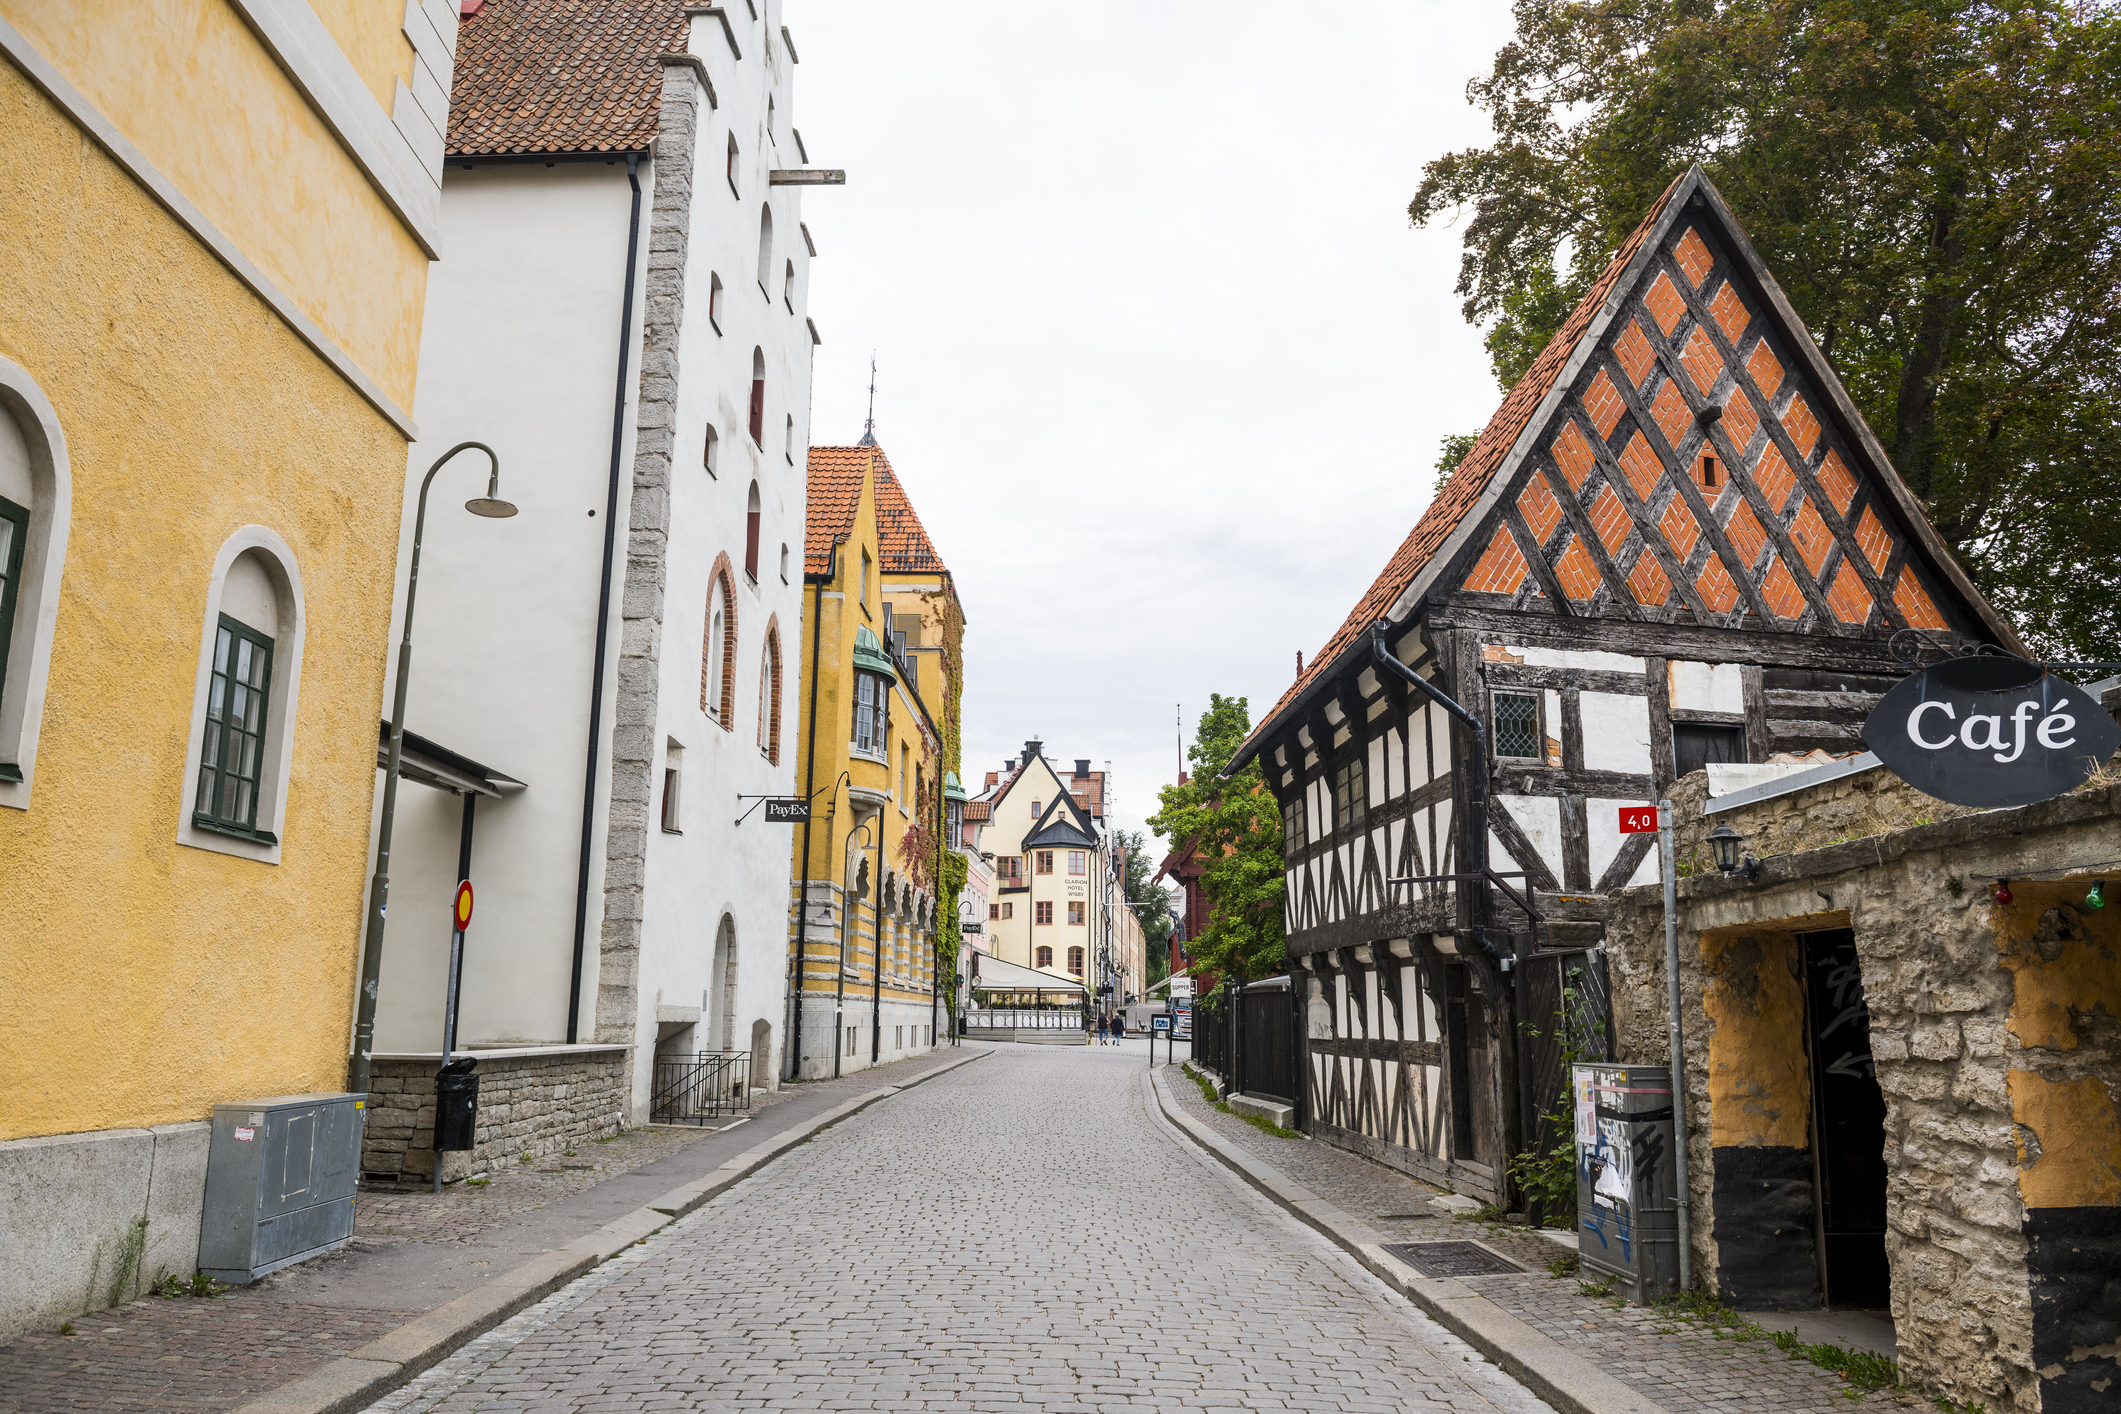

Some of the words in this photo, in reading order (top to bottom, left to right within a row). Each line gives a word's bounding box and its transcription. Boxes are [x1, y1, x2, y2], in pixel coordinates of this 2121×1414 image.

[1906, 698, 2077, 763] Café
[769, 803, 808, 818] PayEx
[1627, 814, 1651, 830] 4,0
